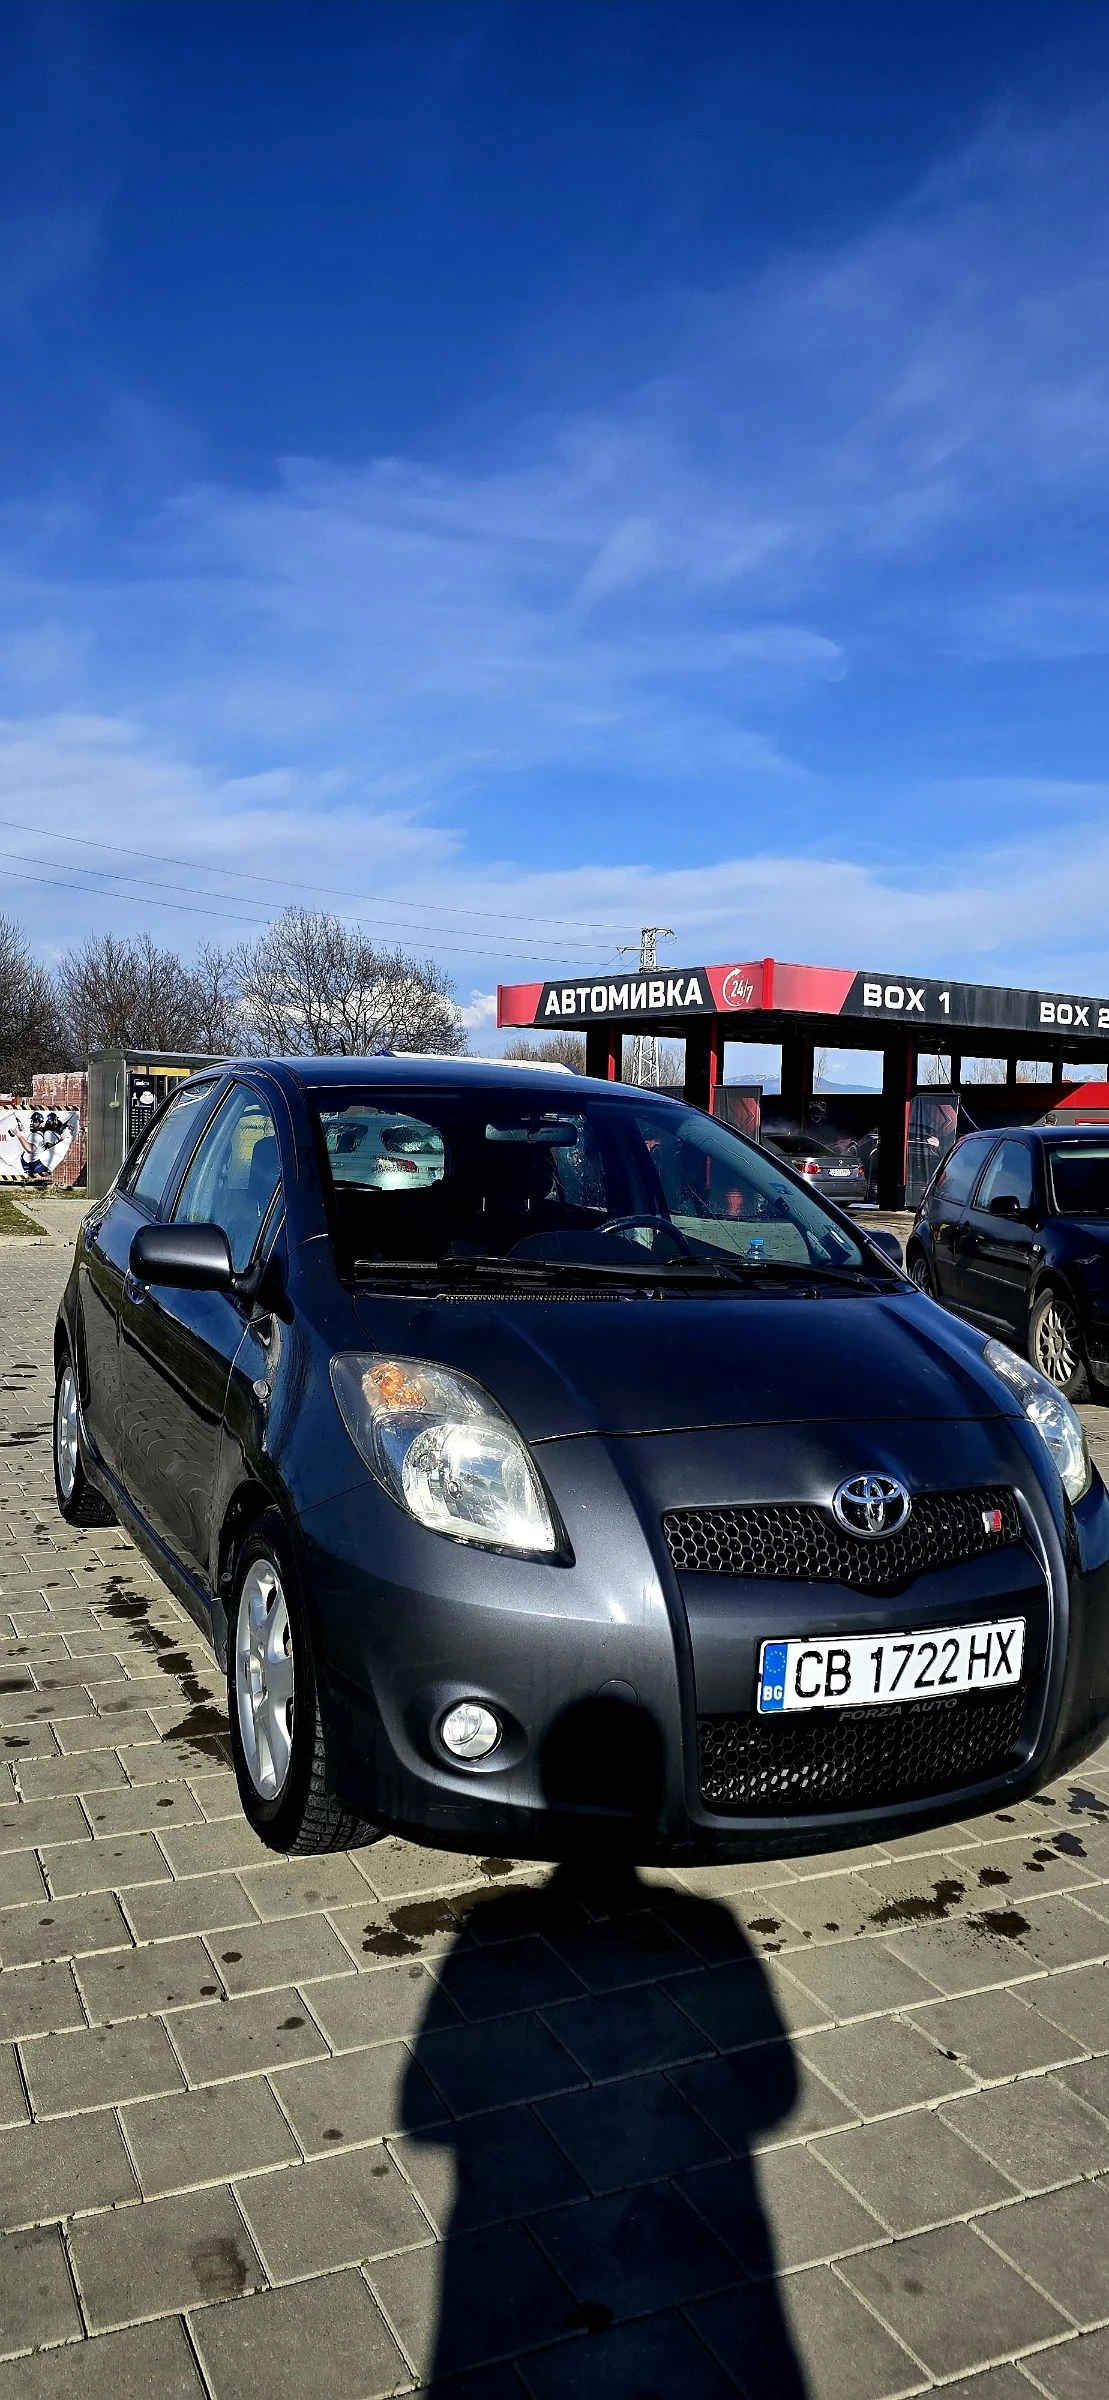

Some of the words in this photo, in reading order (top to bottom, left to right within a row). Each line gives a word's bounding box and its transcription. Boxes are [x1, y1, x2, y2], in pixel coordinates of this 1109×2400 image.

[544, 977, 704, 1016] АВТОМИВКА
[730, 978, 754, 1004] 24/7
[862, 982, 926, 1012] BOX
[938, 991, 951, 1014] 1
[1039, 1001, 1091, 1027] BOX
[1097, 1007, 1109, 1028] 2
[794, 1648, 852, 1698] CB
[870, 1638, 960, 1694] 1722
[967, 1629, 1017, 1681] HX
[762, 1685, 783, 1702] BG
[838, 1705, 902, 1722] FORZA
[907, 1698, 958, 1714] AUTO
